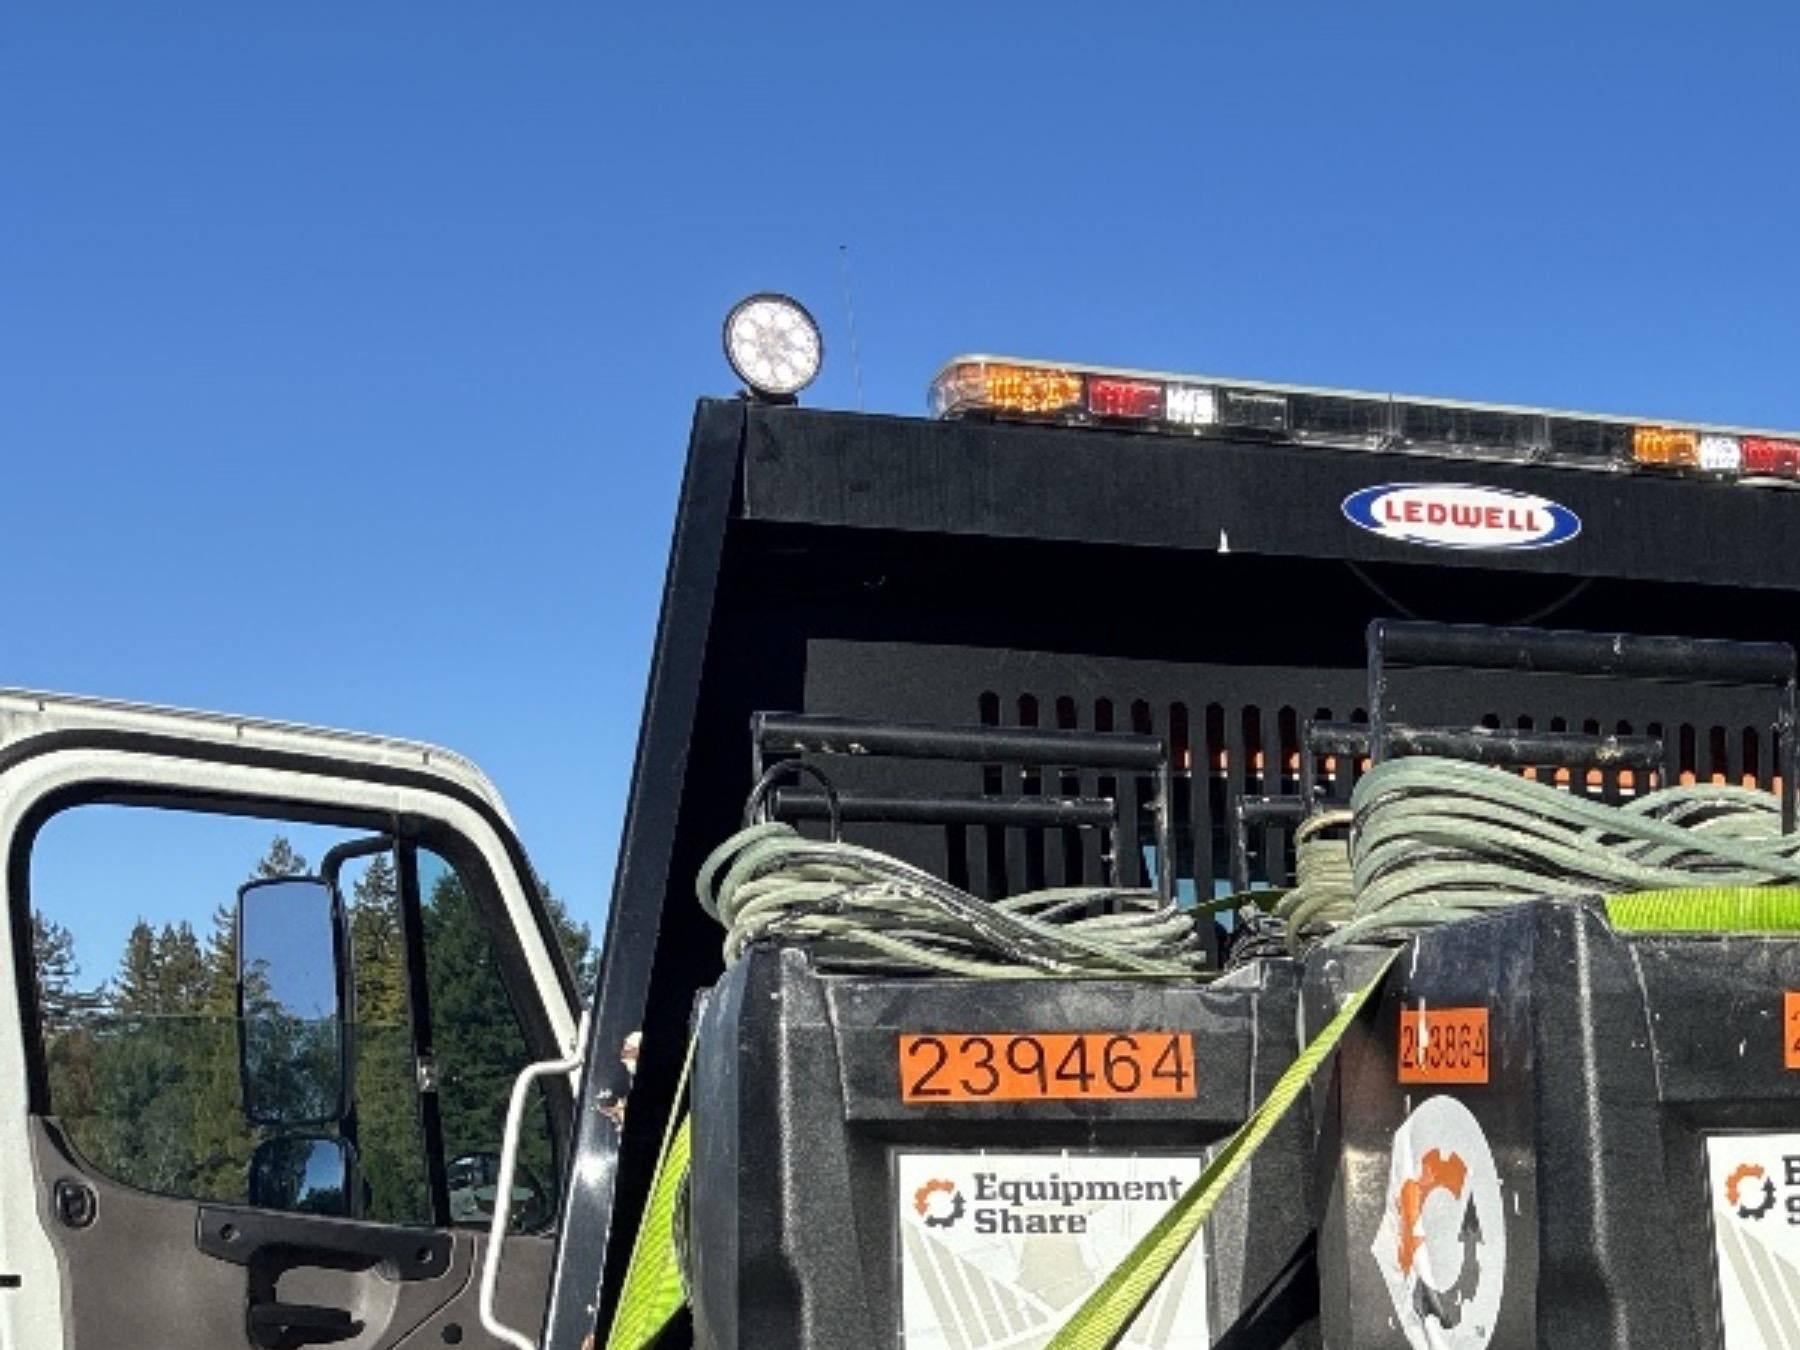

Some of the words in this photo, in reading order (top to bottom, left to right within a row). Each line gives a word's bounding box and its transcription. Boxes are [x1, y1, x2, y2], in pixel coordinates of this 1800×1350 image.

[1385, 499, 1541, 532] LEDWELL
[1402, 1024, 1486, 1068] 23864
[907, 1036, 1190, 1096] 239464
[974, 1172, 1183, 1203] Equipment
[974, 1209, 1087, 1234] Share
